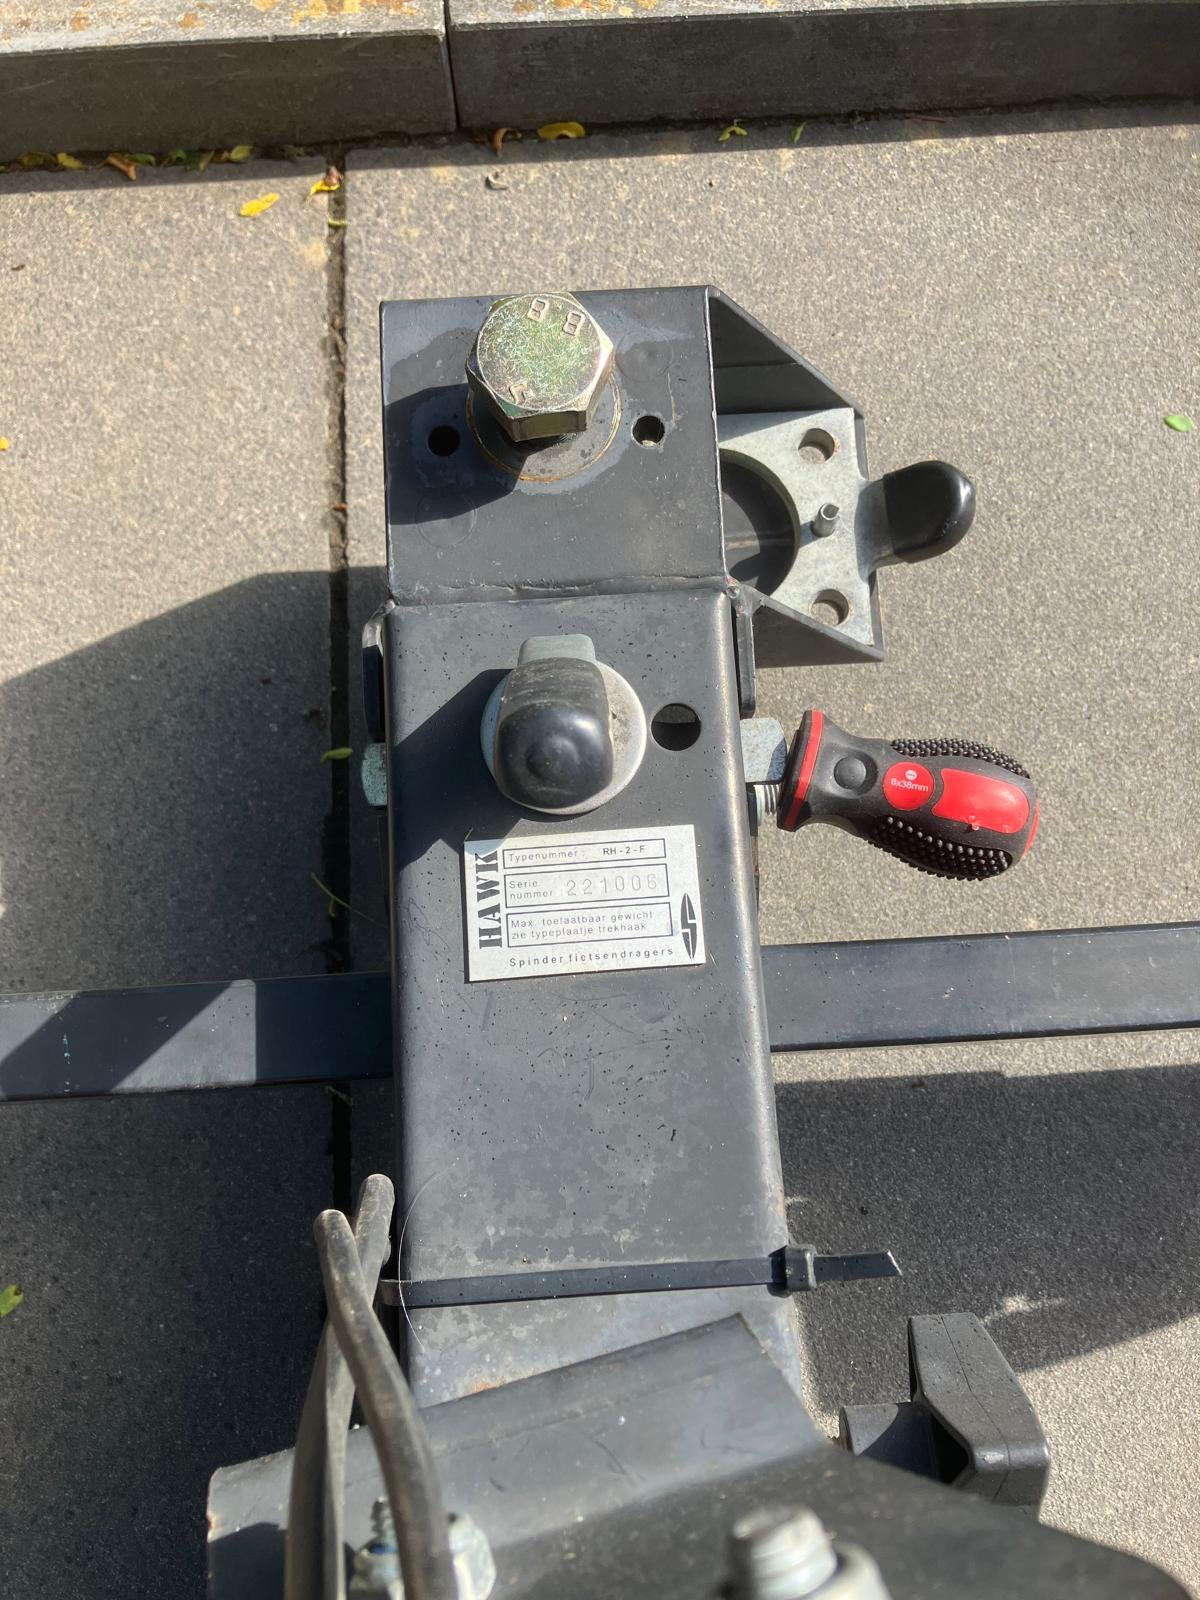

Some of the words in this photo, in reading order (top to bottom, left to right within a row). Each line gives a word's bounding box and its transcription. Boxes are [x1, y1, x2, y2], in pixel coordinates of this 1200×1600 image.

[890, 777, 929, 792] 6x38mm
[509, 880, 538, 889] Serie
[475, 850, 502, 949] HAWK
[542, 914, 606, 926] toelaatbaar
[611, 911, 654, 922] gewicht
[511, 931, 527, 940] zie
[531, 926, 594, 939] typeplaatje
[598, 923, 646, 933] trekhaak
[509, 955, 564, 968] Spinder
[569, 948, 674, 962] fietsendragers
